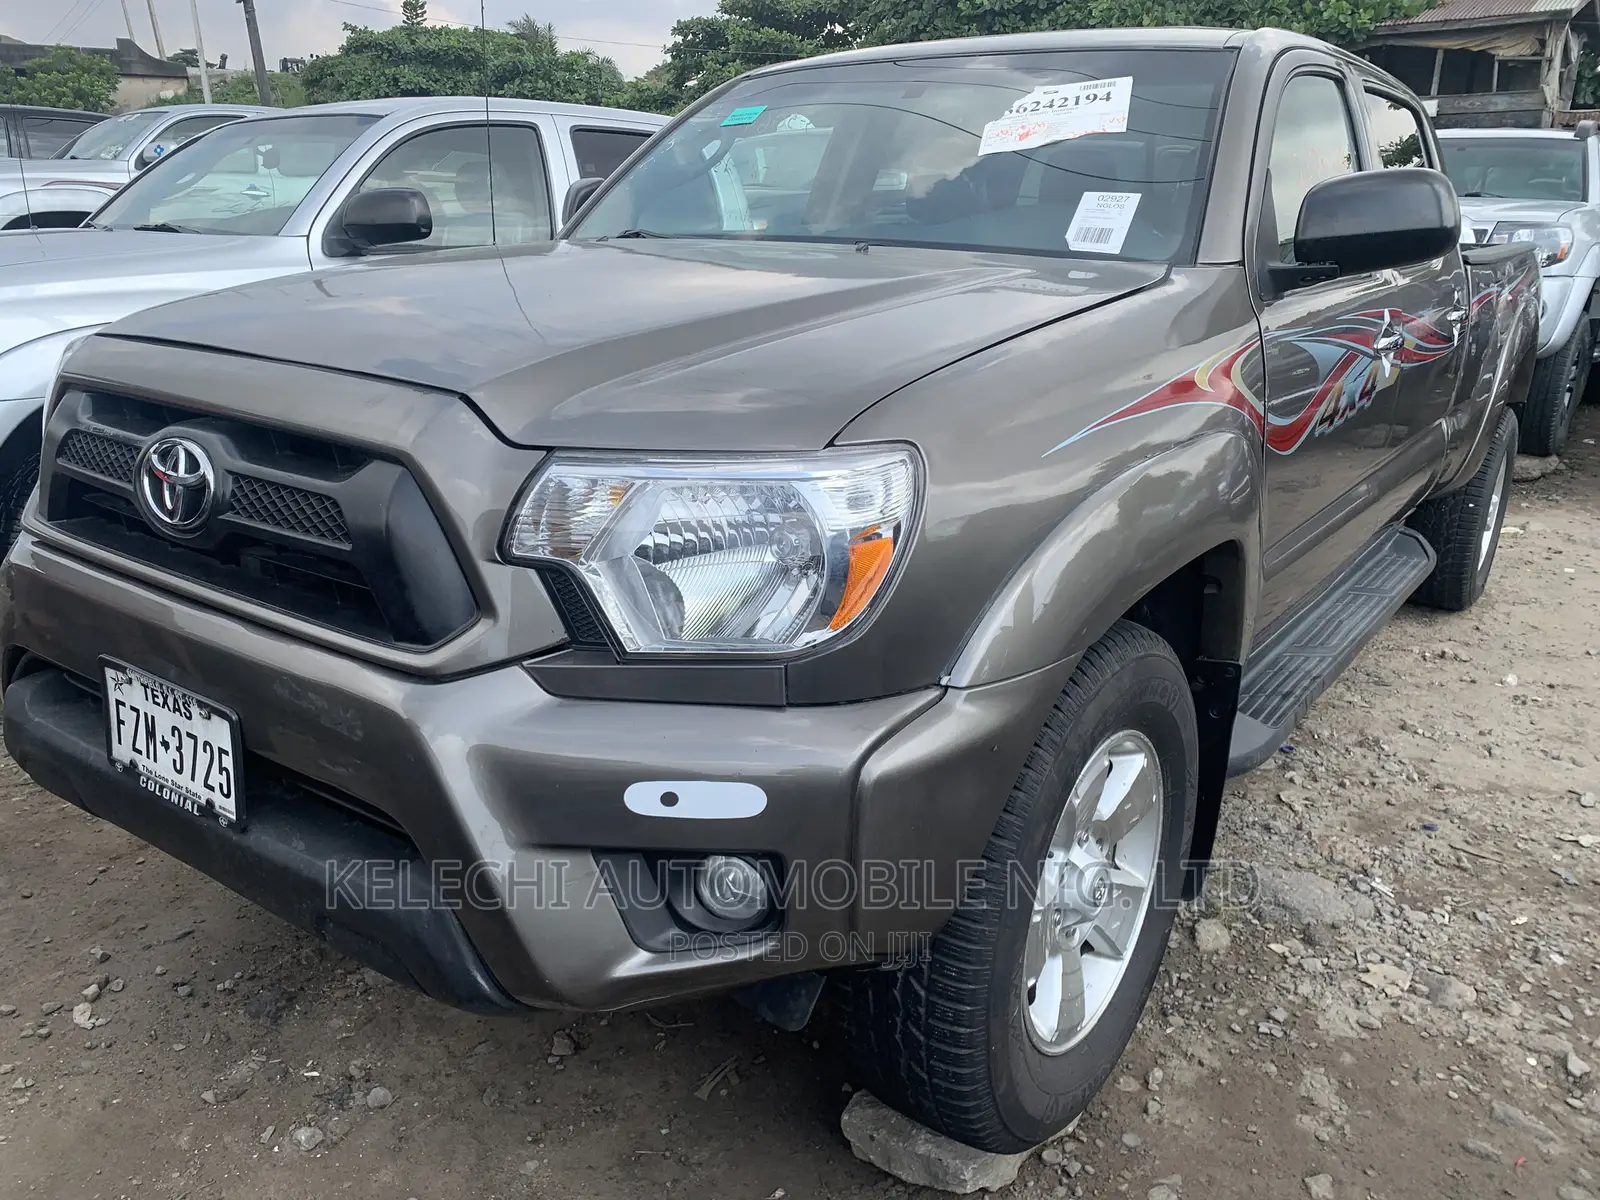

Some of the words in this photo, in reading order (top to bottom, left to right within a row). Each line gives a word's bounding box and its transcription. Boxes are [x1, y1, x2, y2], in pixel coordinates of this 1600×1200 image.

[1097, 194, 1131, 203] 02927
[140, 683, 194, 721] TEXAS
[139, 775, 201, 816] COLONIAL
[141, 764, 154, 776] The
[154, 770, 170, 784] Lone
[170, 779, 184, 791] Star
[184, 786, 203, 801] State
